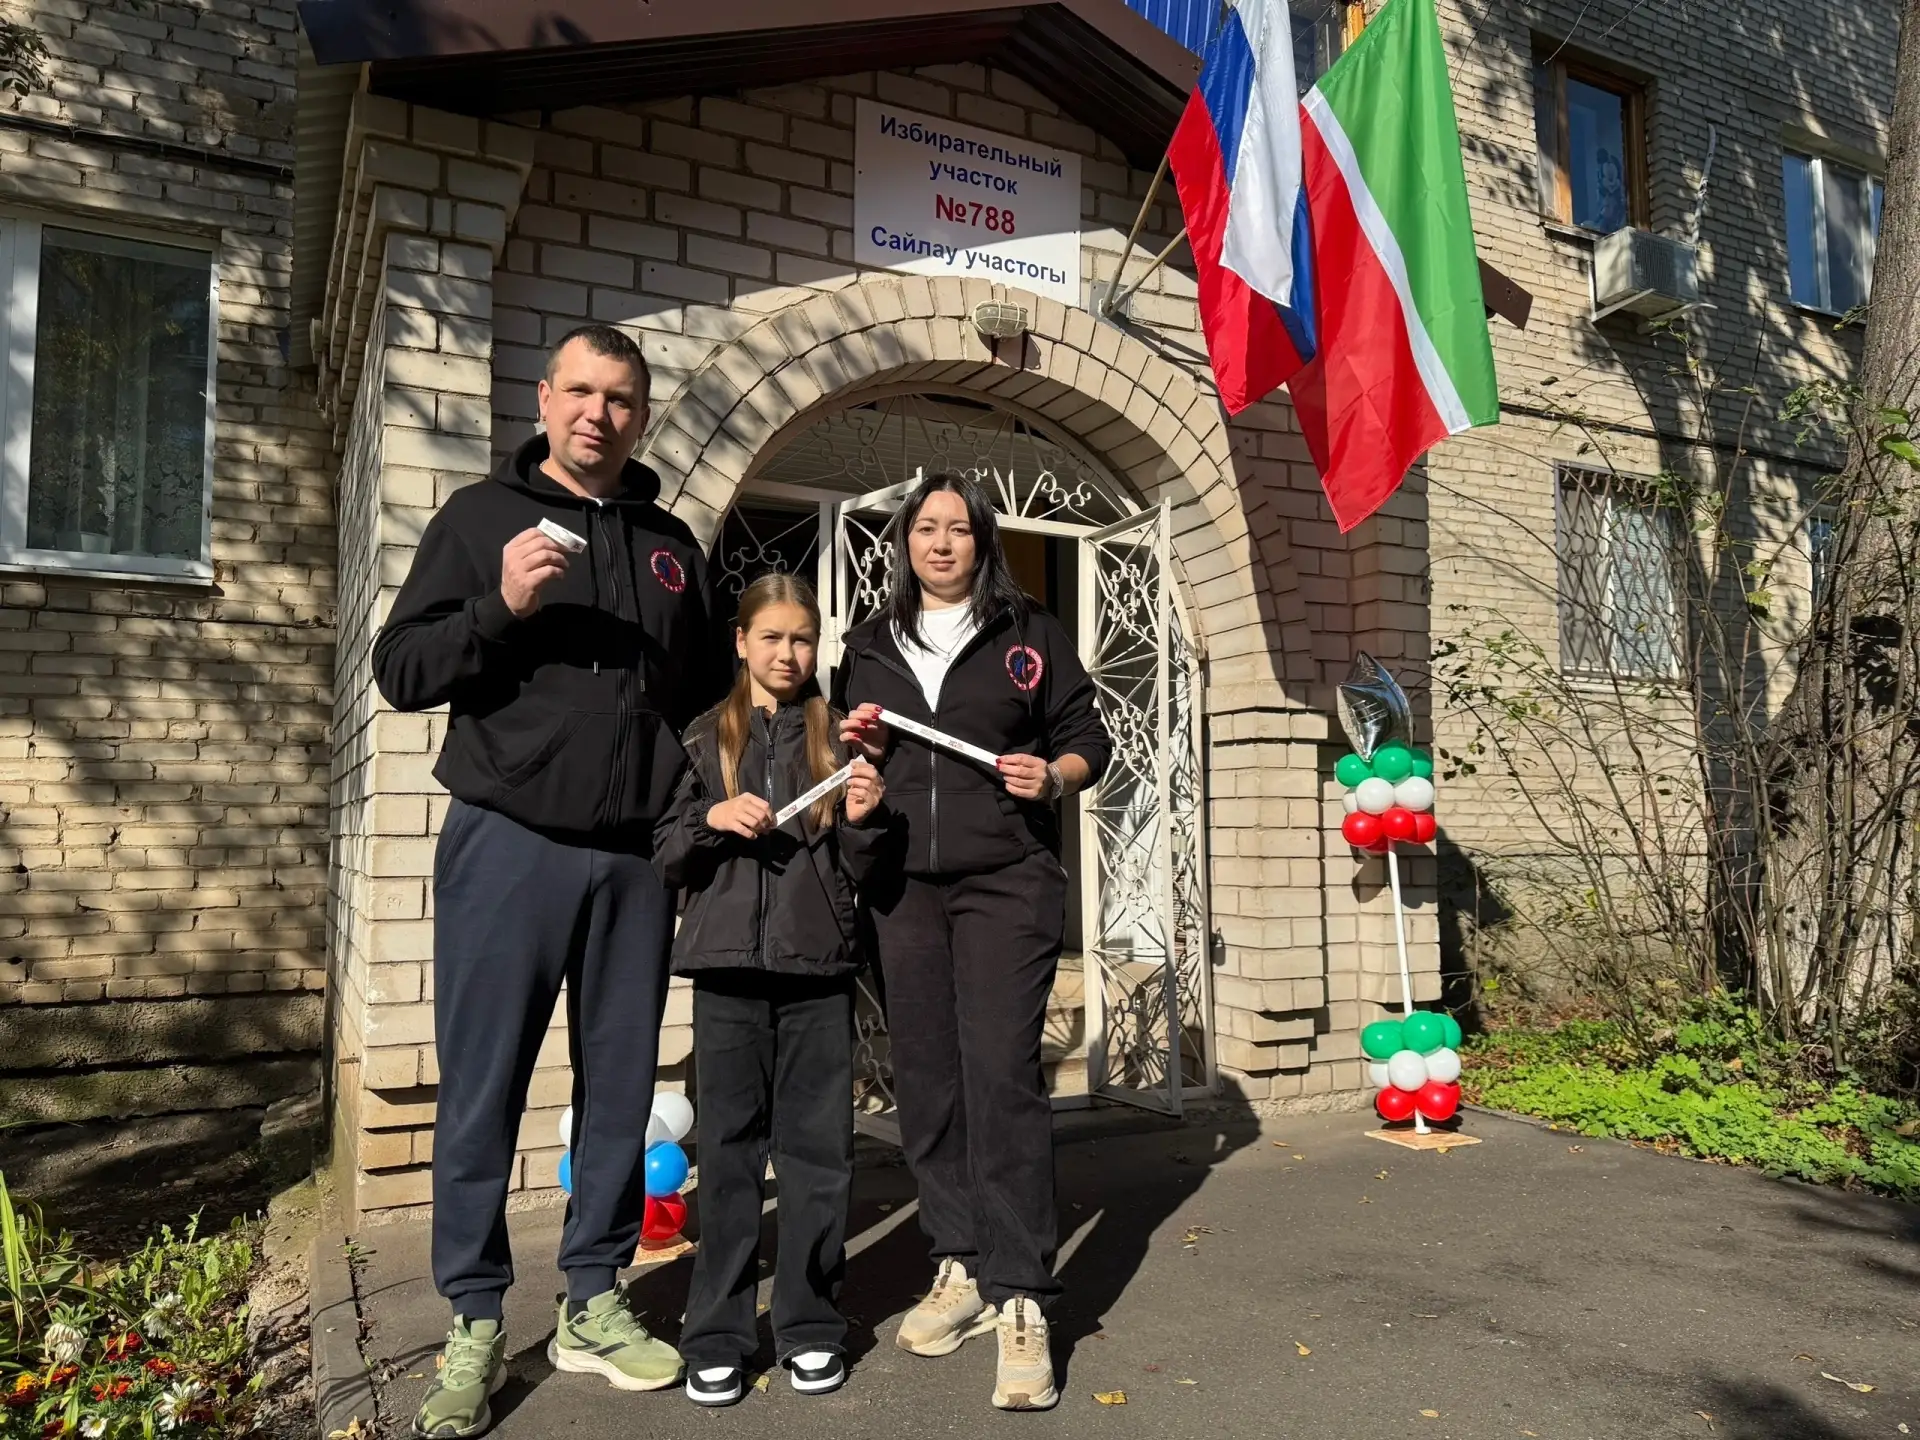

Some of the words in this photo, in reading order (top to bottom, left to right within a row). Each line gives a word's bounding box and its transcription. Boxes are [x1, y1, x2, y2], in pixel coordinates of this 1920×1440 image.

[880, 114, 1062, 178] Избирательный
[929, 160, 1018, 195] участок
[935, 193, 1016, 235] №788
[870, 226, 958, 265] Сайлау
[965, 249, 1066, 284] участогы
